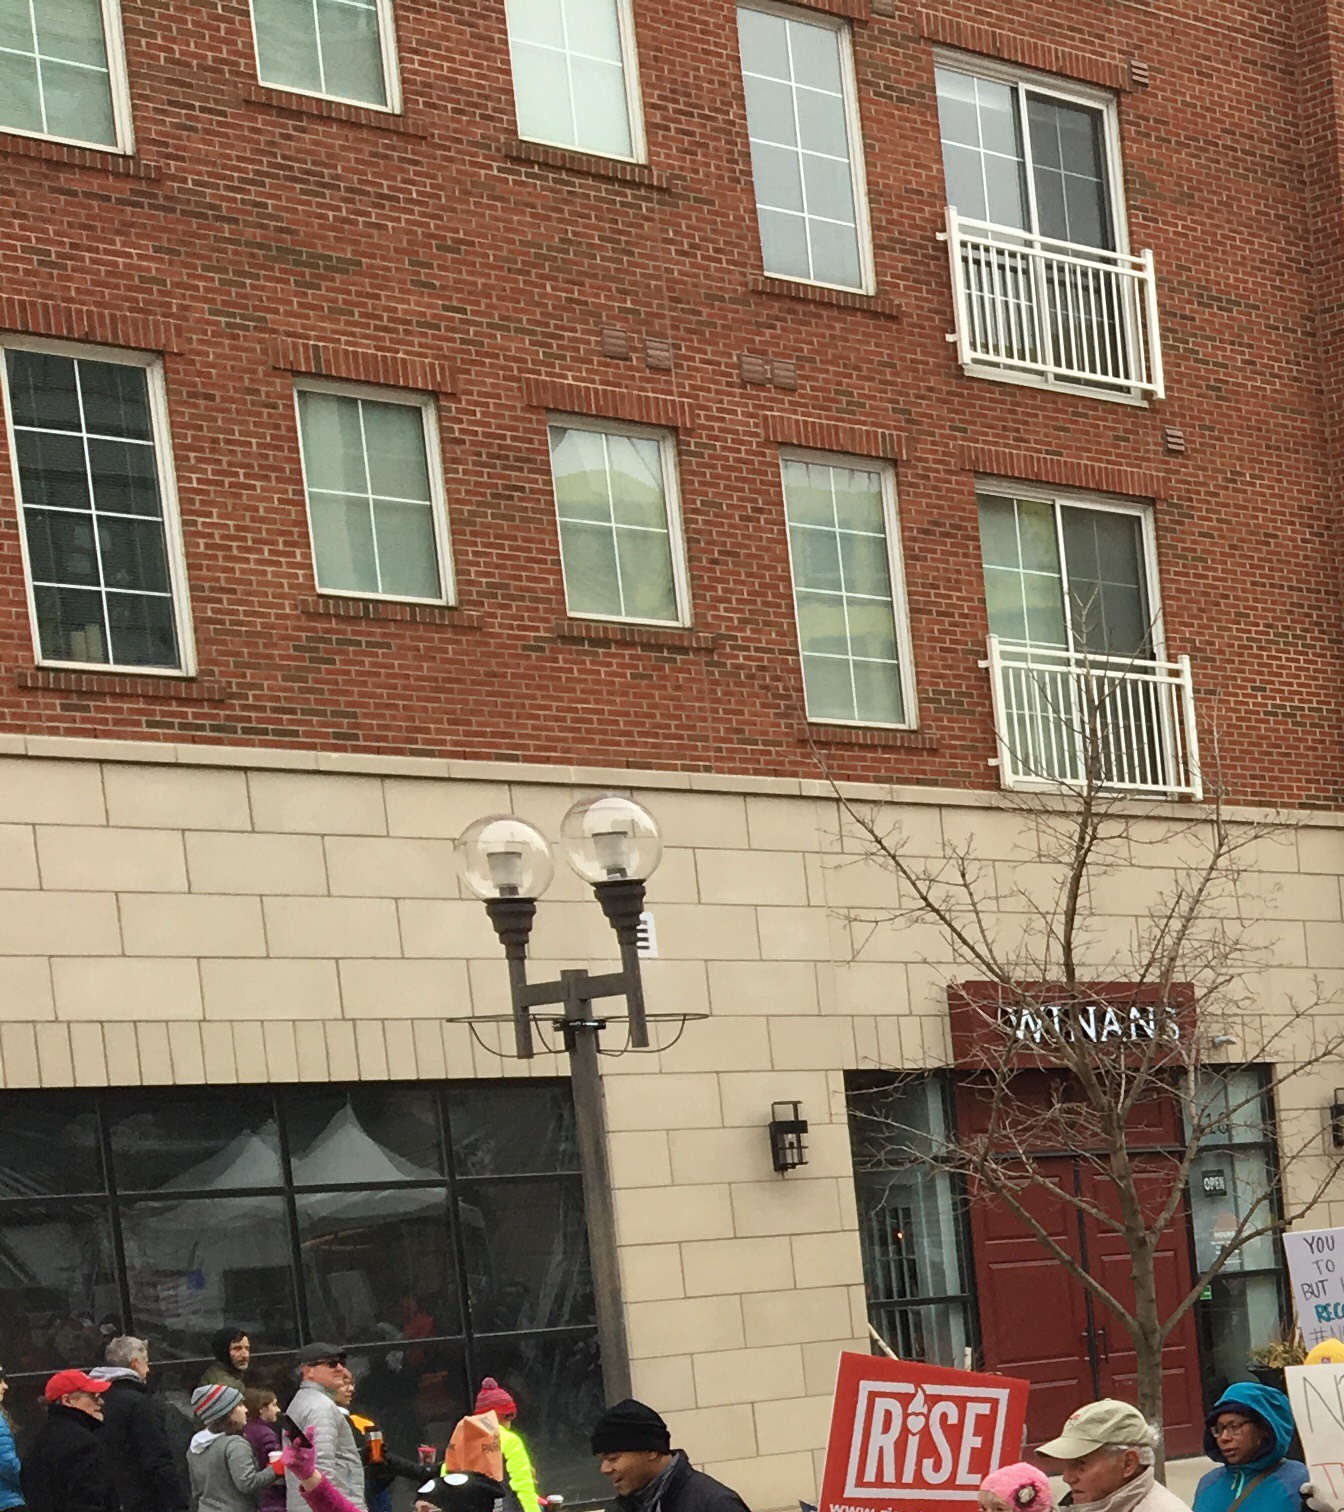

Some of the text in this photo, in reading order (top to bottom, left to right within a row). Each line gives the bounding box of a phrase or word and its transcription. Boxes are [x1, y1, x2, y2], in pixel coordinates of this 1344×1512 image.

[1001, 1005, 1180, 1043] WINANS
[1204, 1176, 1225, 1191] OPEN
[1303, 1235, 1335, 1255] YOU
[1312, 1258, 1335, 1275] TO
[1301, 1278, 1329, 1301] BUT
